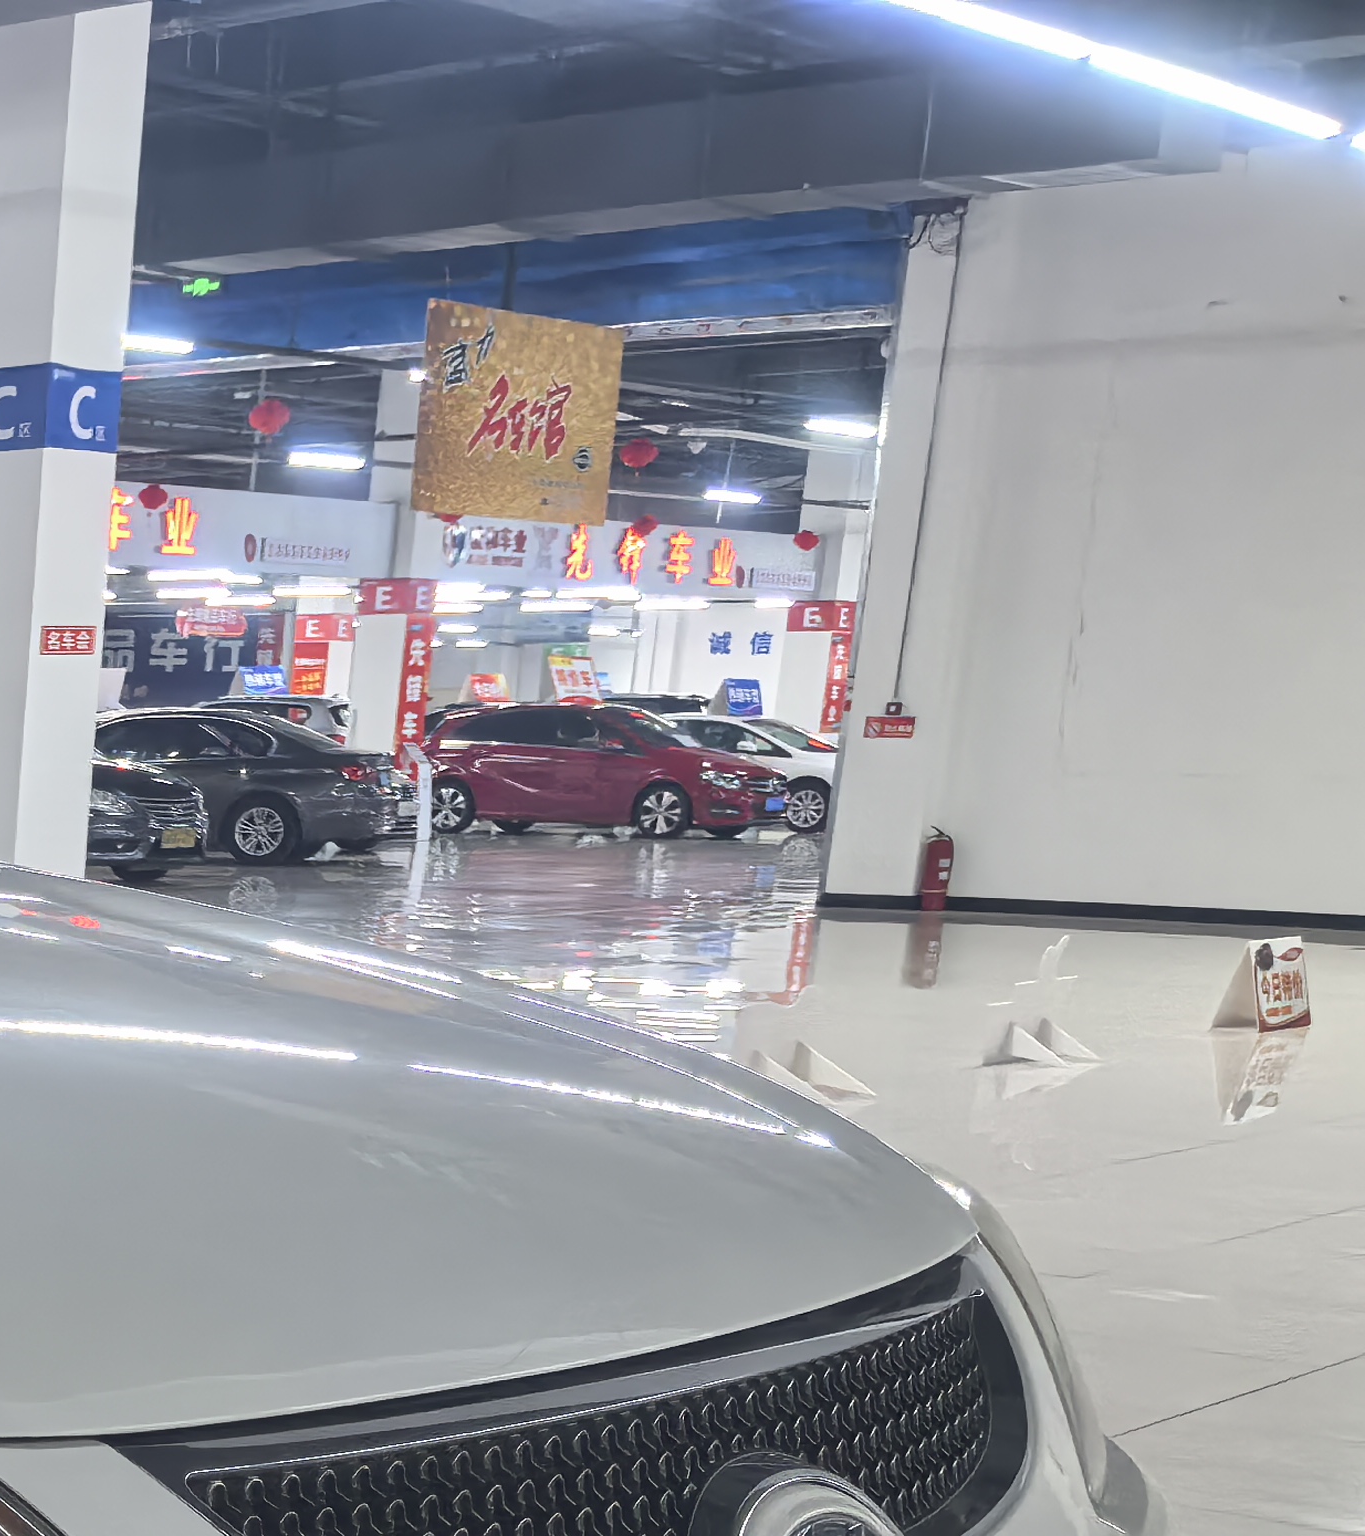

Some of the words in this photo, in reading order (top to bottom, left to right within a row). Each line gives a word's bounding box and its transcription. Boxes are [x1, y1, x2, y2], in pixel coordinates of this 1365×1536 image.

[69, 385, 97, 440] C
[565, 522, 739, 587] 先锋车业
[375, 583, 394, 611] E
[708, 631, 773, 656] 诚信
